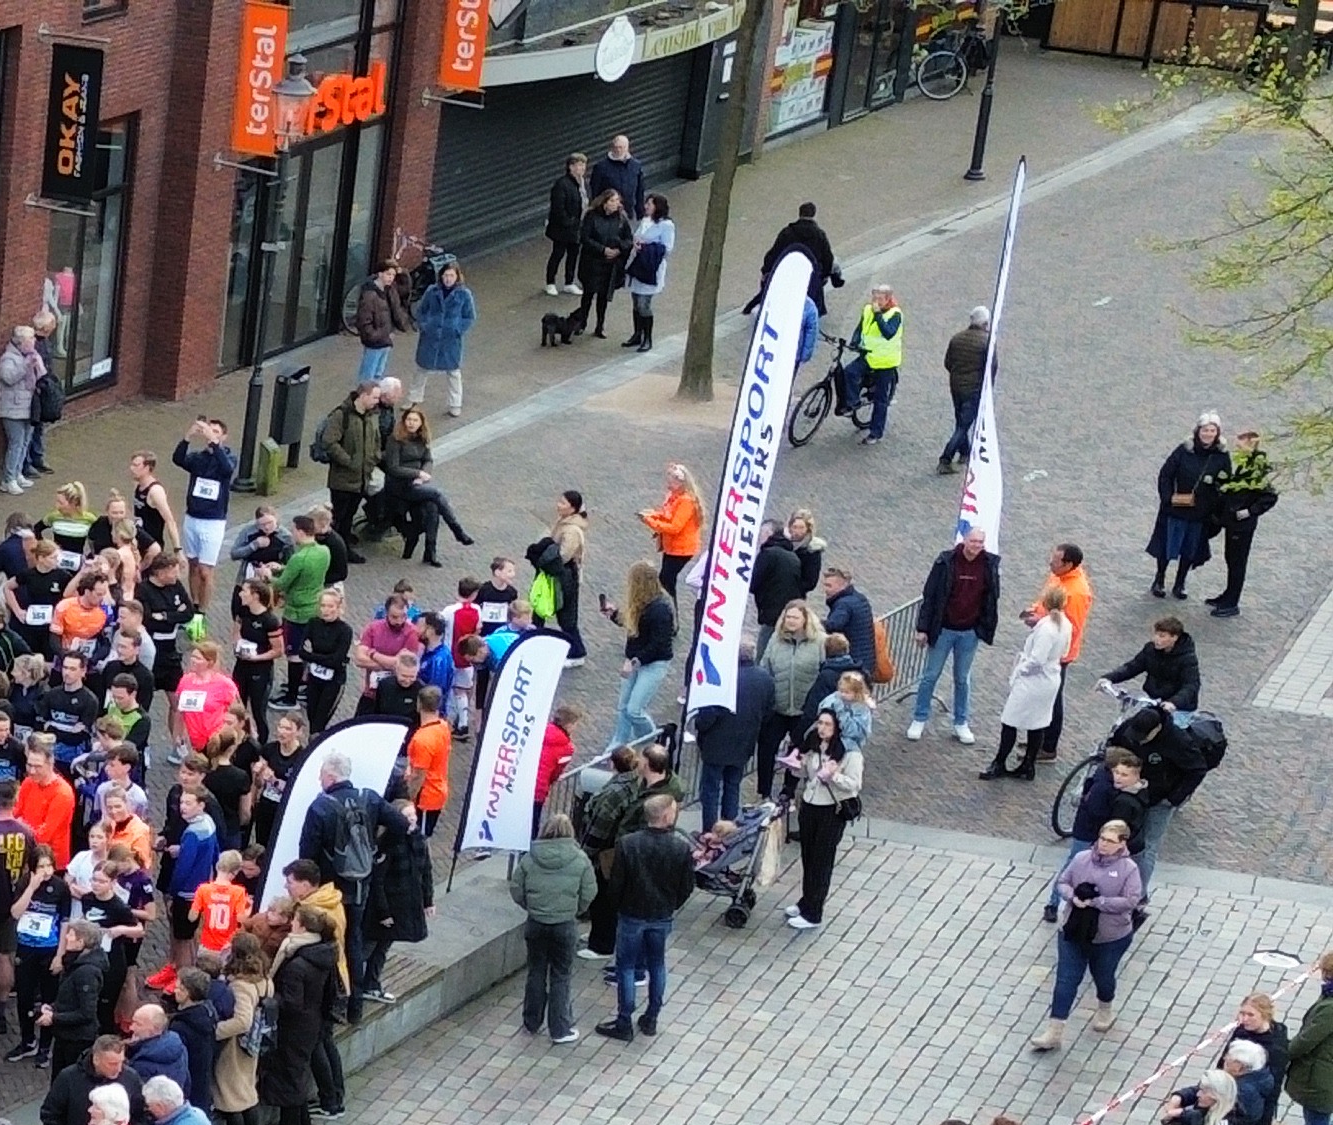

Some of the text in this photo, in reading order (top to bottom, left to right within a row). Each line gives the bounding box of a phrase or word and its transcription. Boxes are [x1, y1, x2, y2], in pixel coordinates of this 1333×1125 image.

[246, 24, 277, 136] terStal
[452, 0, 484, 72] terSt
[58, 72, 80, 175] OKAY
[303, 60, 387, 136] rStal
[703, 312, 779, 641] INTERSPORT
[486, 659, 532, 819] INTERSPORT
[207, 903, 231, 930] 10
